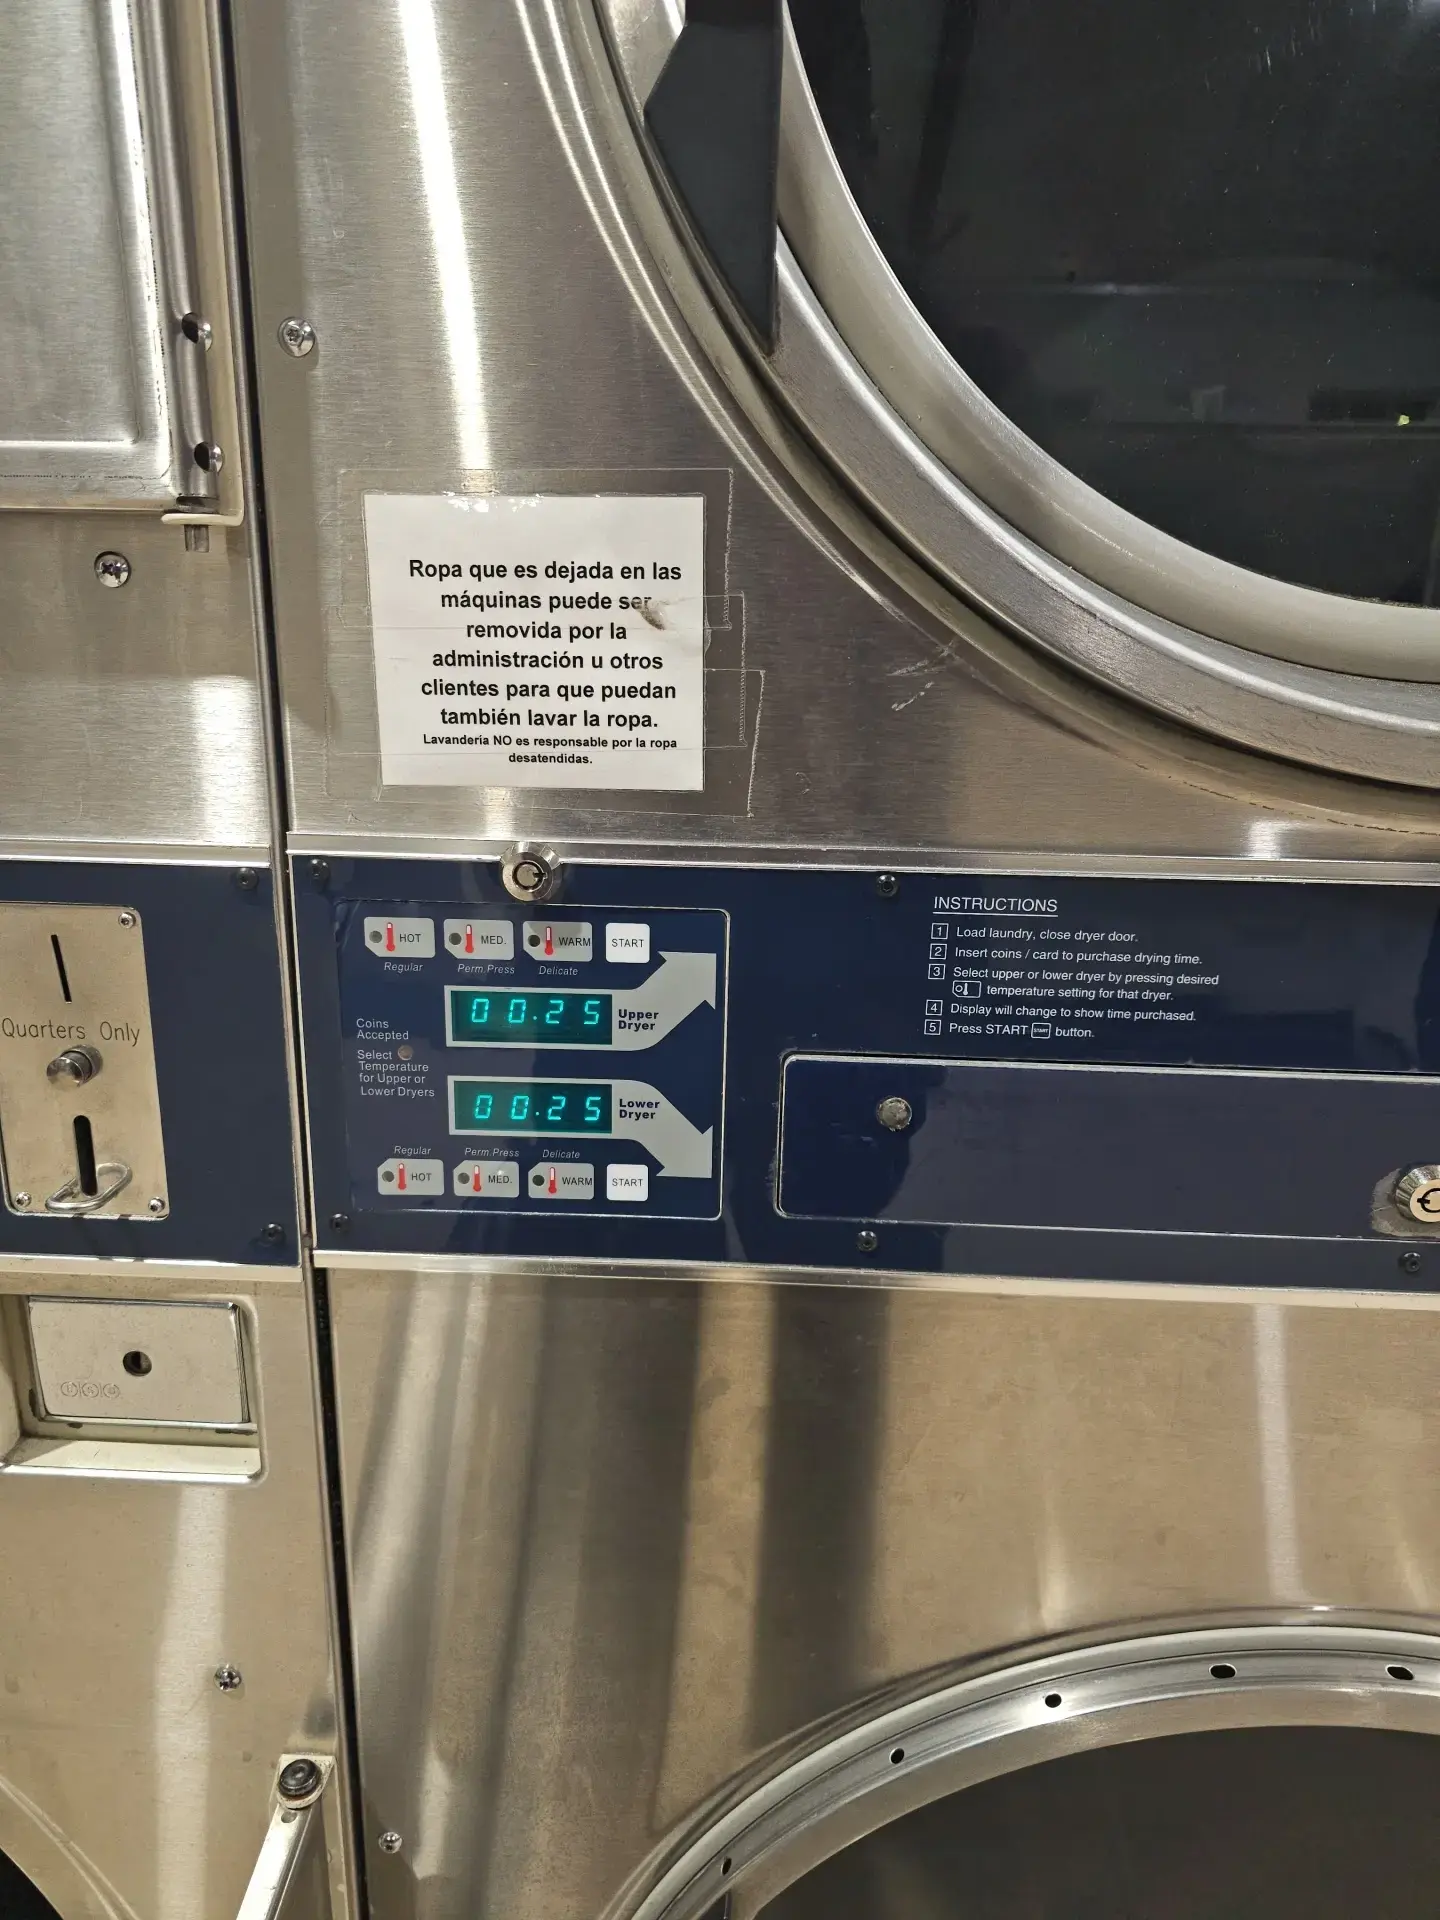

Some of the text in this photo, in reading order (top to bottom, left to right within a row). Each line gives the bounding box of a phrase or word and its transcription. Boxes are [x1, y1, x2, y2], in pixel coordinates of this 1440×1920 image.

[410, 560, 681, 583] Ropa que es dejada en las
[442, 590, 651, 613] máquinas puede ser
[467, 622, 626, 643] removida por la
[433, 650, 663, 669] administración u otros
[422, 679, 675, 702] clientes para que puedan
[441, 709, 657, 731] también lavar la ropa.
[424, 734, 489, 745] Lavandería
[494, 735, 512, 745] NO
[534, 737, 608, 748] responsable
[613, 740, 632, 749] por
[636, 738, 645, 747] la
[651, 740, 677, 750] ropa
[509, 753, 592, 763] desatendidas.
[933, 897, 1057, 913] INSTRUCTIONS
[400, 934, 421, 942] HOT
[481, 936, 506, 944] MED.
[957, 927, 986, 937] Load
[990, 928, 1035, 941] laundry,
[1040, 929, 1070, 939] close
[1075, 930, 1105, 942] dryer
[1108, 931, 1137, 941] door.
[559, 937, 590, 946] WARM
[612, 939, 644, 947] START
[956, 947, 987, 957] Insert
[991, 950, 1021, 958] coins
[1024, 948, 1031, 960] /
[1033, 950, 1058, 959] card
[1062, 951, 1073, 960] to
[1077, 951, 1131, 962] purchase
[1135, 953, 1170, 965] drying
[1174, 954, 1202, 964] time.
[384, 962, 423, 973] Regular
[539, 966, 578, 975] Delicate
[954, 967, 988, 977] Select
[992, 971, 1024, 980] upper
[1043, 970, 1073, 980] lower
[1076, 971, 1105, 983] dryer
[1109, 972, 1122, 984] by
[1125, 975, 1173, 985] pressing
[1177, 974, 1219, 984] desired
[987, 986, 1172, 1002] temperature setting for that dryer.
[619, 1009, 659, 1022] Upper
[951, 1004, 991, 1016] Display
[995, 1006, 1012, 1014] will
[1016, 1006, 1057, 1018] change
[1061, 1008, 1071, 1017] to
[1075, 1008, 1104, 1017] show
[1108, 1009, 1131, 1018] time
[1134, 1010, 1195, 1021] purchased.
[357, 1018, 388, 1028] Coins
[619, 1019, 655, 1032] Dryer
[2, 1018, 140, 1047] Quarters Only
[357, 1030, 408, 1041] Accepted
[950, 1023, 981, 1033] Press
[986, 1024, 1028, 1034] START
[1056, 1027, 1093, 1037] button.
[358, 1050, 392, 1062] Select
[359, 1061, 428, 1075] Temperature
[360, 1073, 374, 1082] for
[378, 1073, 411, 1085] Upper
[361, 1087, 434, 1098] Lower Dryers
[620, 1099, 660, 1111] Lower
[620, 1109, 655, 1121] Dryer
[394, 1146, 431, 1156] Regular
[543, 1150, 580, 1158] Delicate
[412, 1173, 431, 1181] HOT
[489, 1175, 512, 1183] MED.
[562, 1177, 592, 1185] WARM
[612, 1178, 642, 1186] START
